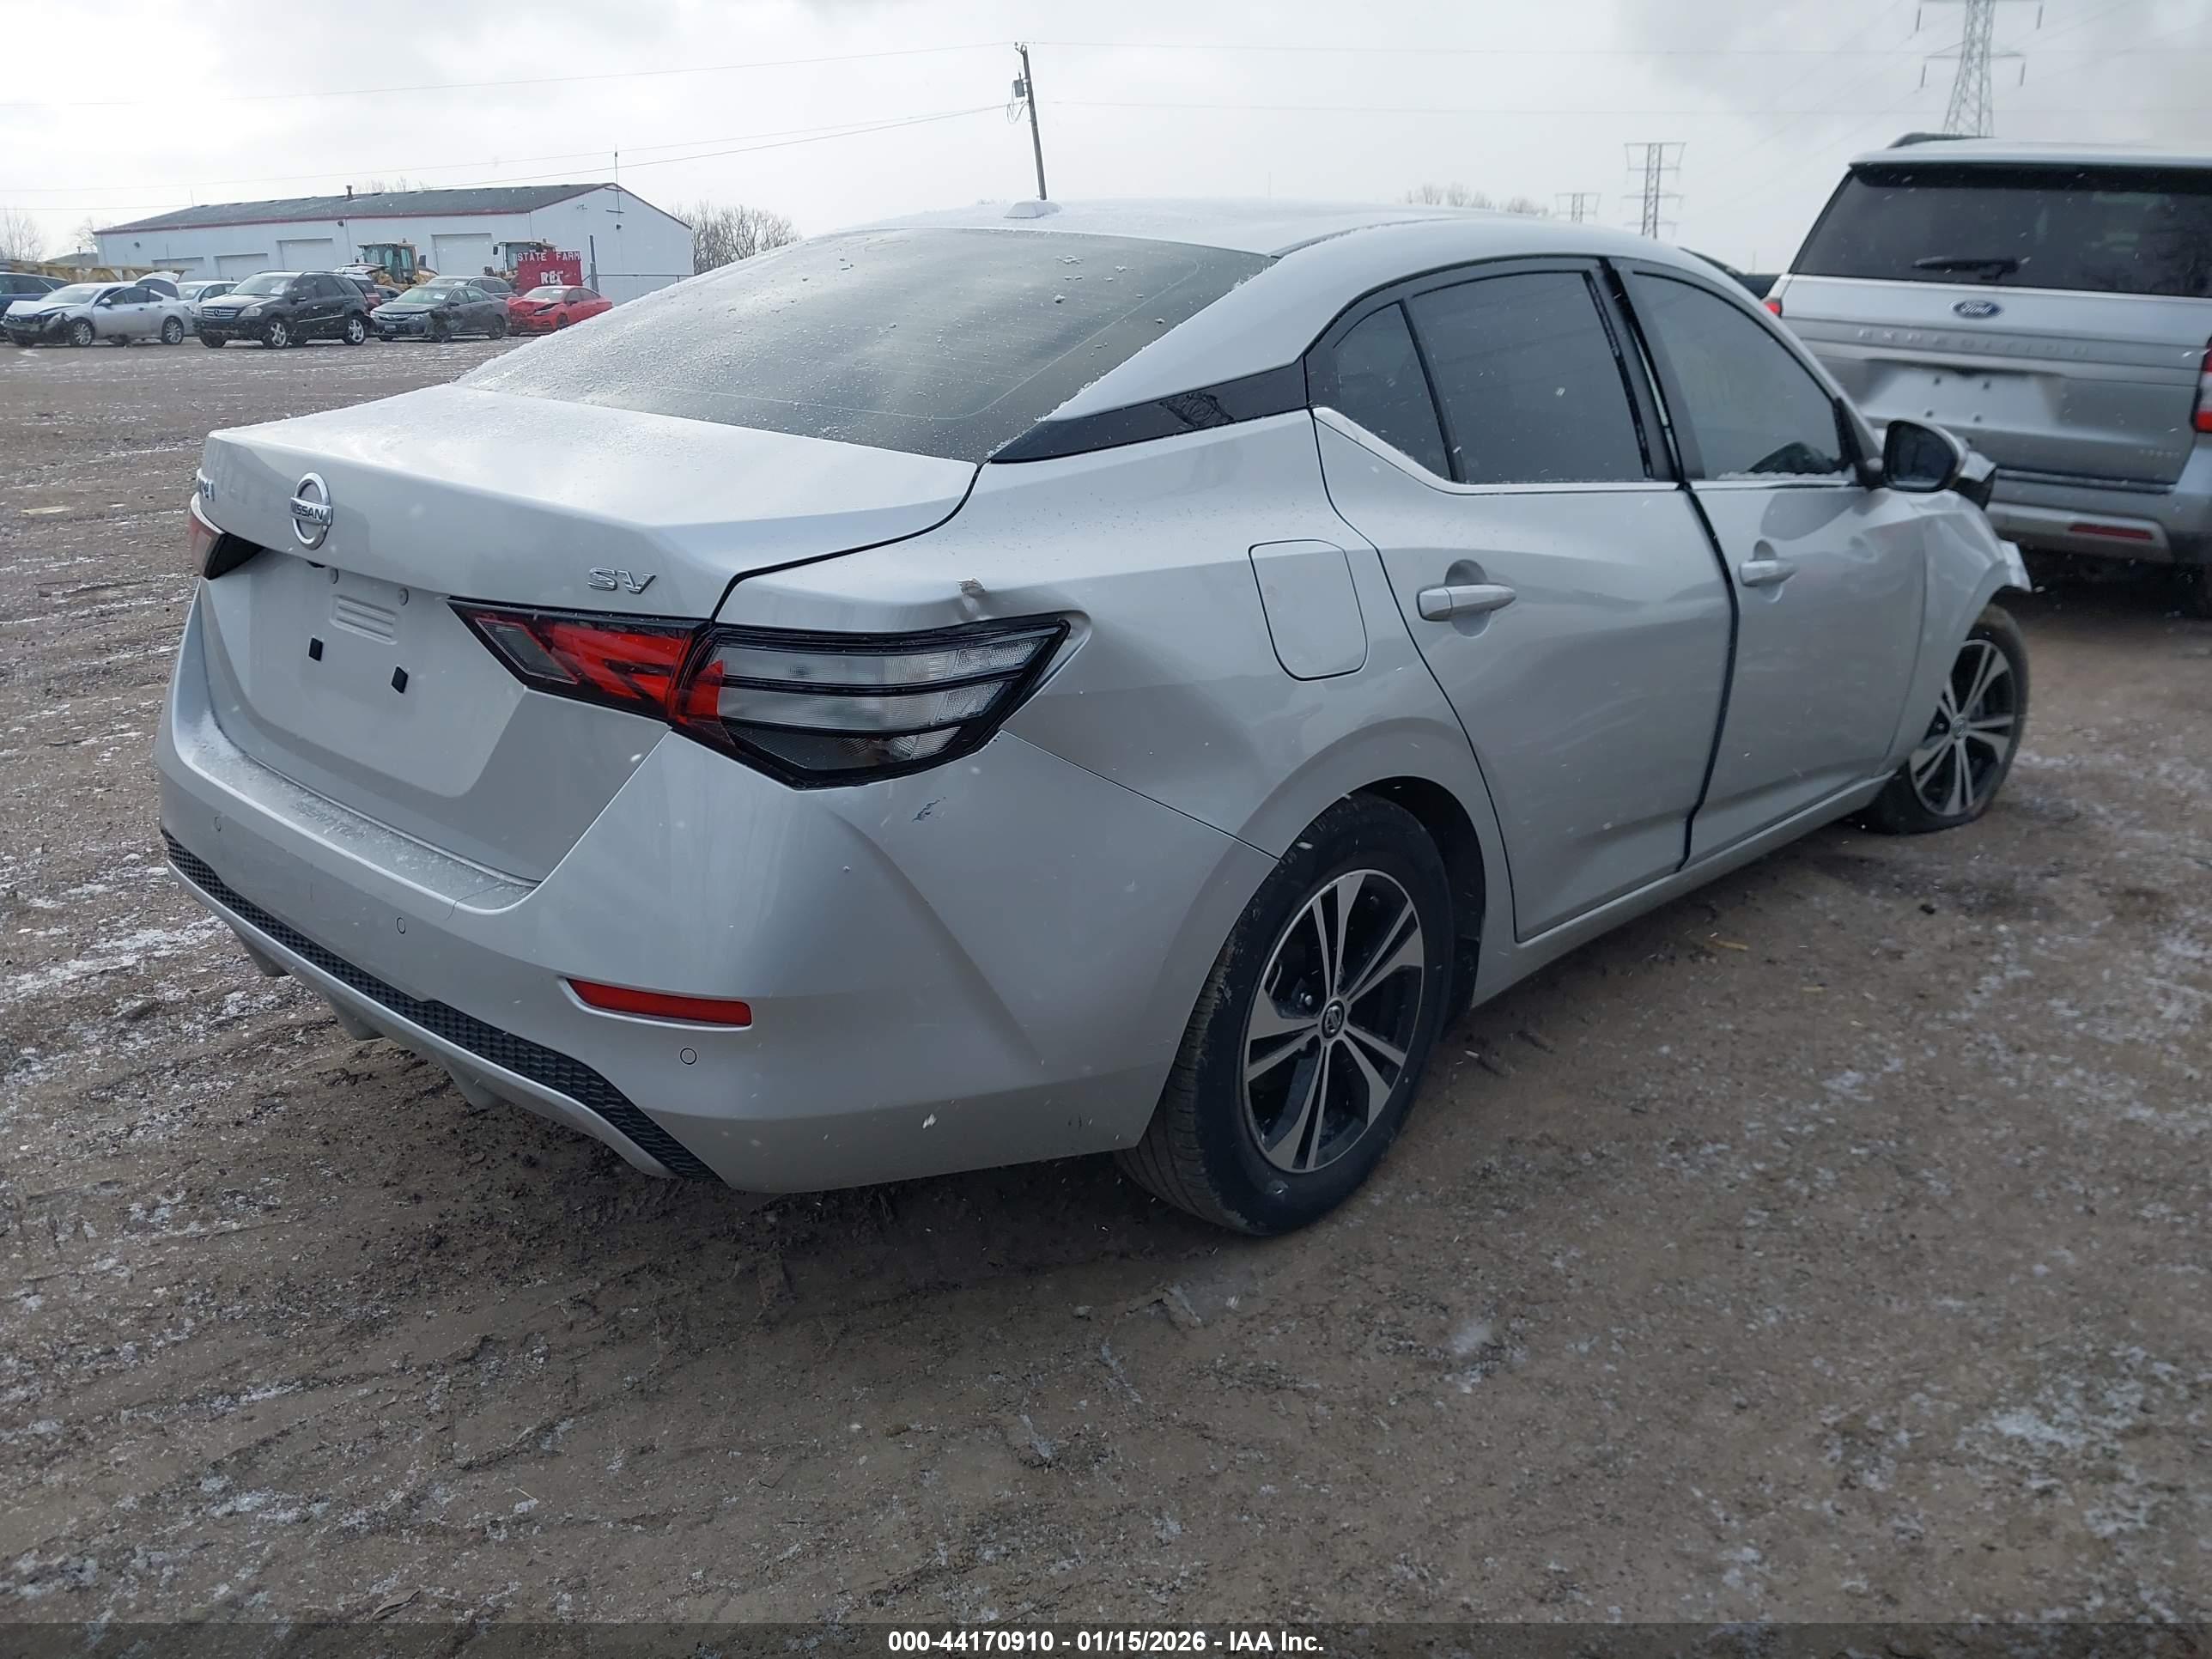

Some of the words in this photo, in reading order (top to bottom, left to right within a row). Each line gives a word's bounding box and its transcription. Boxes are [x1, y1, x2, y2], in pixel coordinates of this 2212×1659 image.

[517, 252, 548, 262] STATE
[556, 252, 582, 262] FARM
[290, 501, 325, 520] NISSAN
[587, 567, 657, 594] SV
